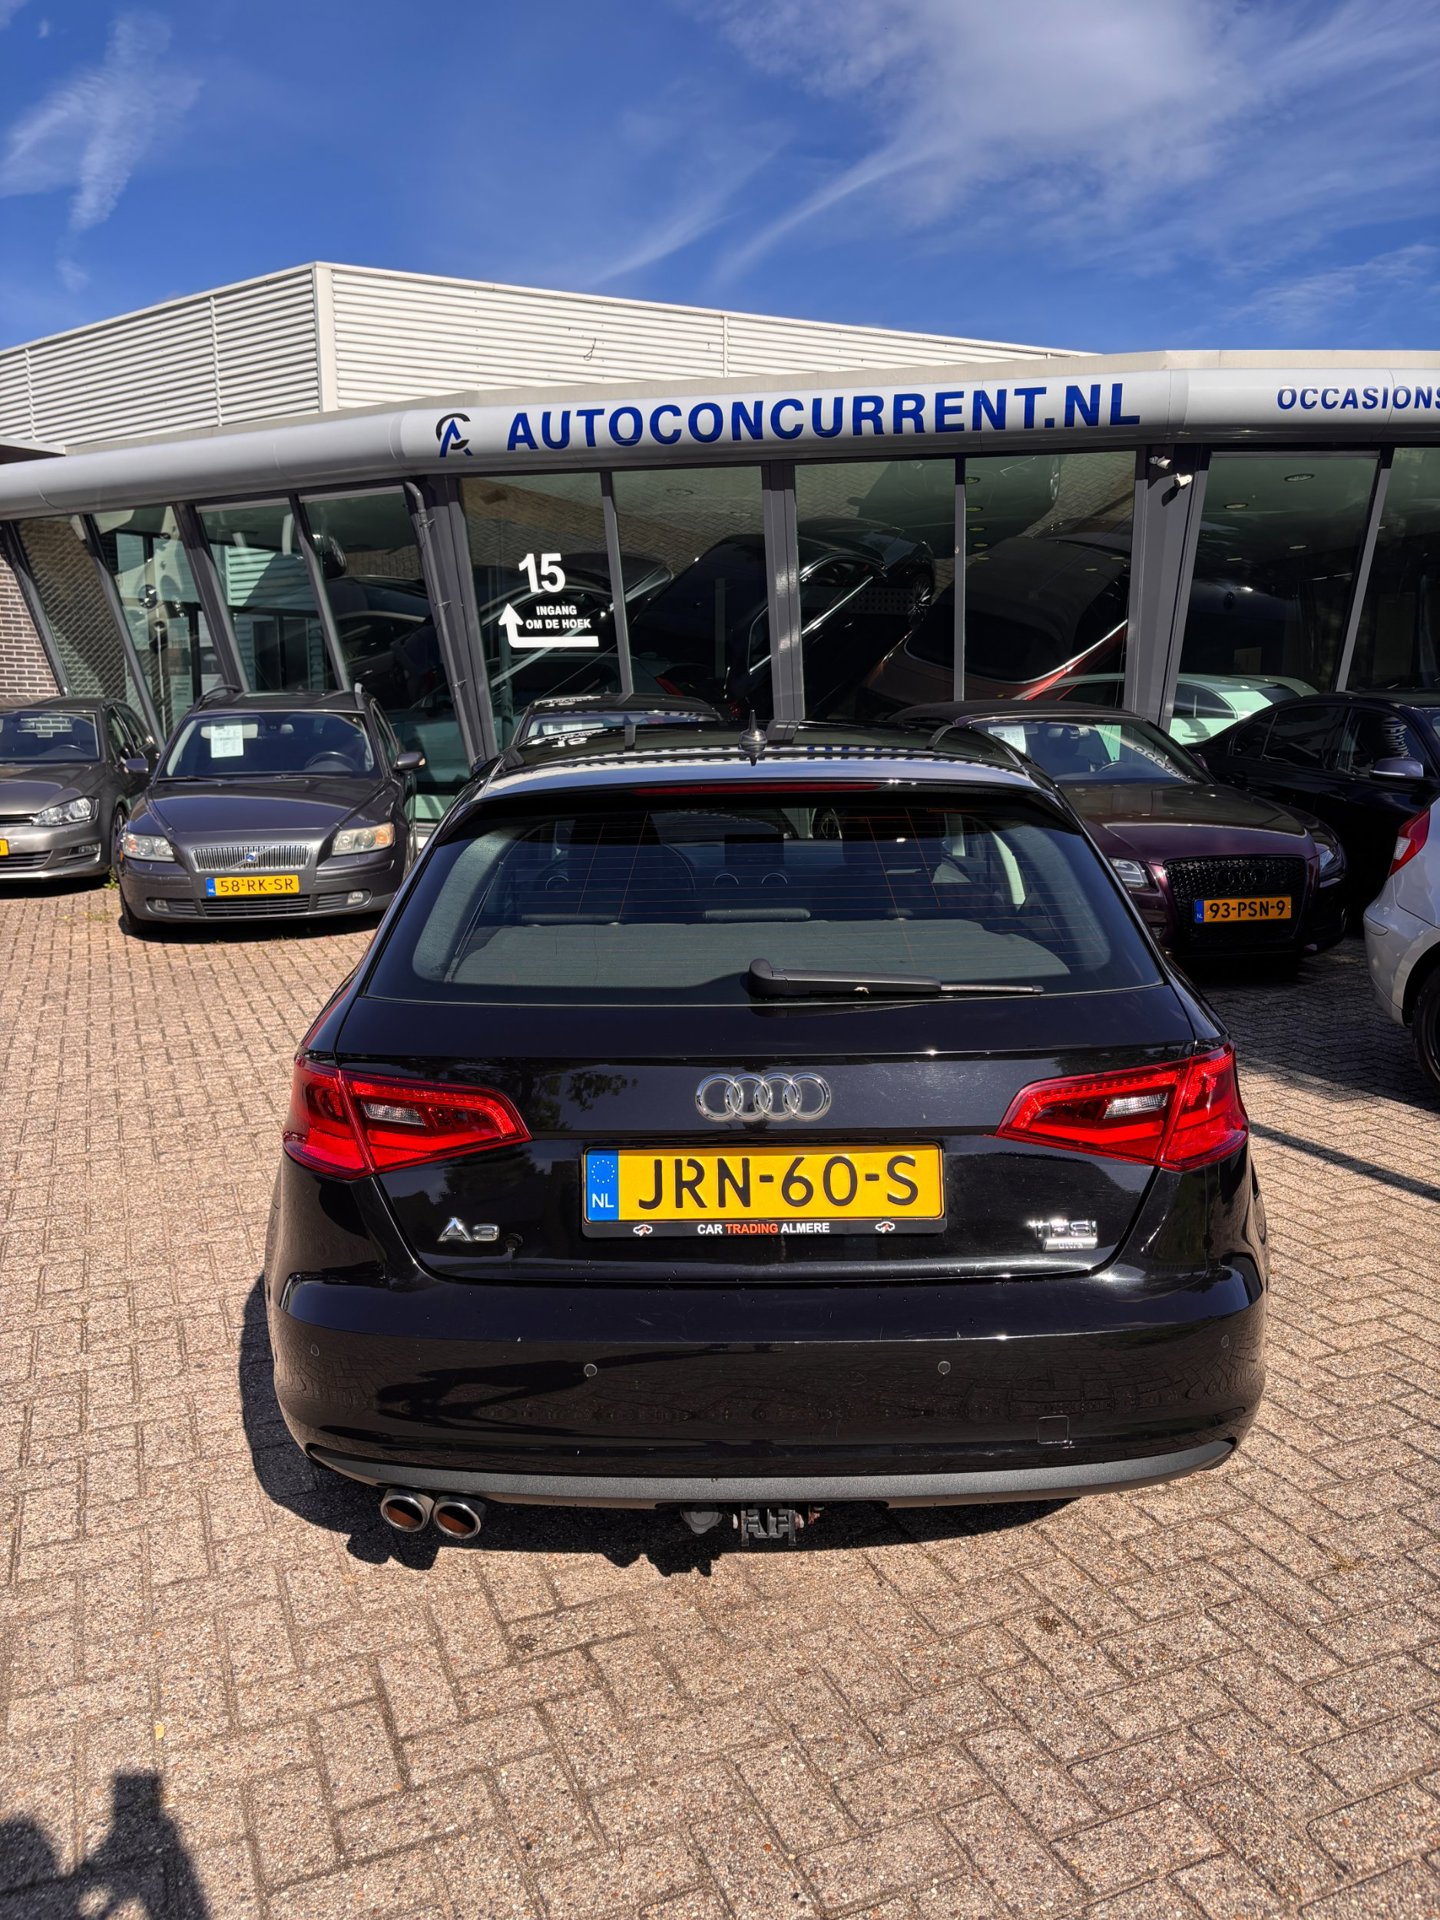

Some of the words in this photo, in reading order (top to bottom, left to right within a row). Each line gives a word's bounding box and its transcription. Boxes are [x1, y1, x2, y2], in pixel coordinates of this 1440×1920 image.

[506, 383, 1140, 451] AUTOCONCURRENT.NL
[518, 553, 566, 593] 15
[536, 605, 577, 616] INGANG
[525, 619, 543, 630] OM
[545, 619, 560, 629] DE
[562, 618, 592, 629] HOEK
[220, 878, 294, 893] 58-RK-SR
[1209, 899, 1286, 919] 93-PSN-9
[591, 1192, 615, 1209] NL
[638, 1155, 919, 1210] JRN-60-S
[437, 1216, 500, 1242] A3
[697, 1223, 723, 1235] CAR
[725, 1223, 779, 1235] TRADING
[781, 1222, 830, 1234] ALMERE
